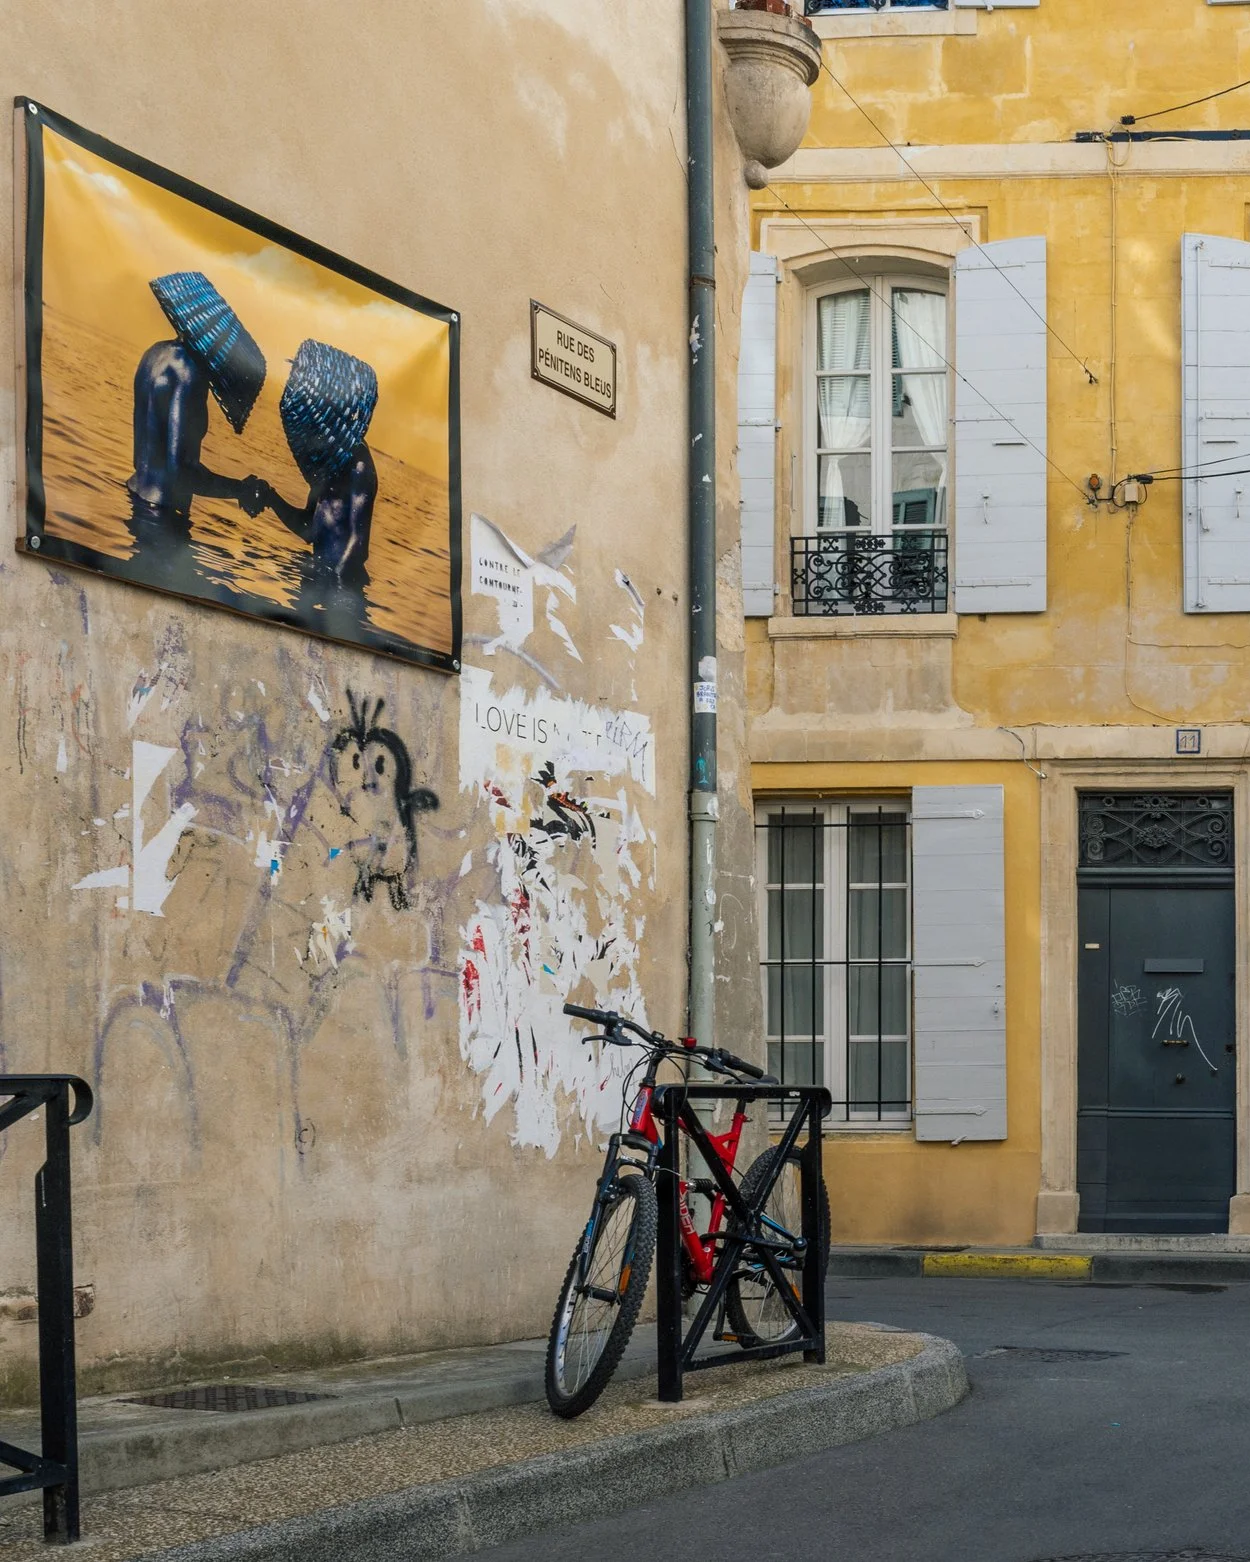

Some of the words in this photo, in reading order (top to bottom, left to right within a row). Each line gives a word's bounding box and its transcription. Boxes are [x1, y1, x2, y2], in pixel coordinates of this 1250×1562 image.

[557, 330, 575, 353] RUE
[578, 341, 595, 363] DES
[538, 347, 582, 383] PÉNITENS
[584, 371, 612, 399] BLEUS
[476, 702, 527, 739] LOVE
[533, 717, 548, 744] IS
[1180, 736, 1195, 748] 11
